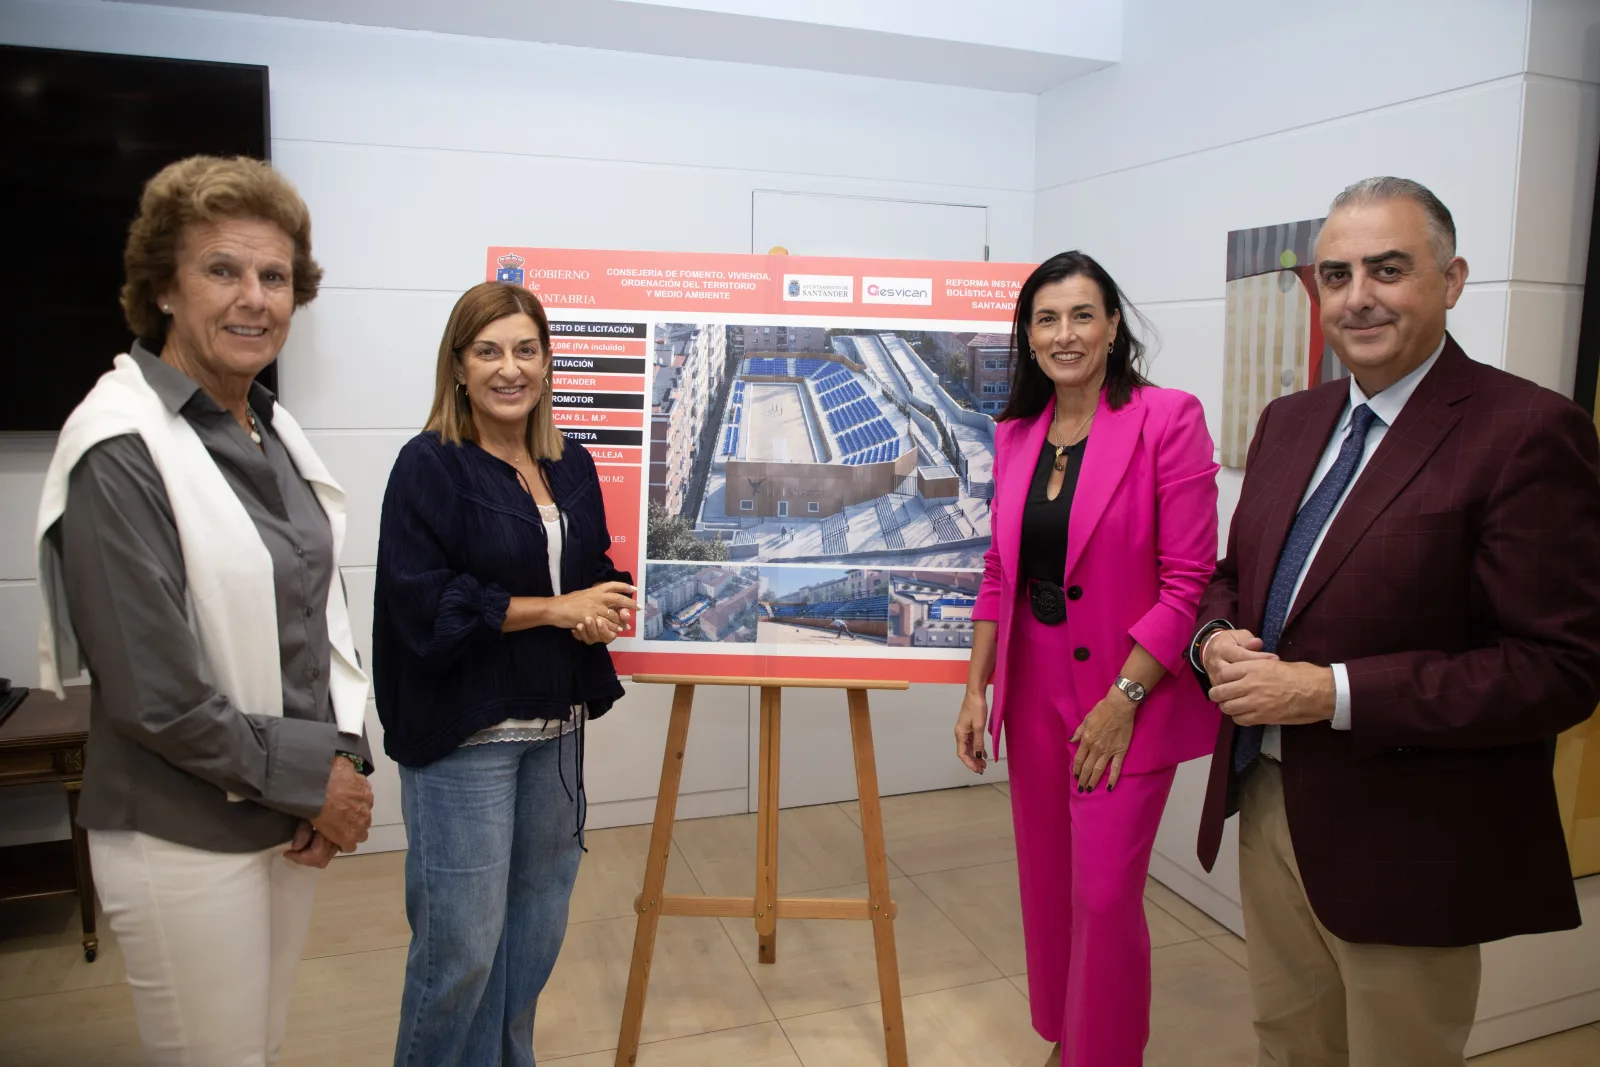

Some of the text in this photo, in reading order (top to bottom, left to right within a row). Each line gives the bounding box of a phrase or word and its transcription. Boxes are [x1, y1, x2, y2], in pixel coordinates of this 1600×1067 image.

[529, 269, 590, 280] GOBIERNO
[606, 268, 771, 281] CONSEJERÍA DE FOMENTO, VIVIENDA,
[528, 281, 540, 291] de
[621, 278, 756, 290] ORDENACIÓN DEL TERRITORIO
[945, 279, 1023, 289] REFORMA INSTAL
[654, 290, 683, 298] MEDIO
[685, 291, 731, 300] AMBIENTE
[802, 290, 849, 298] SANTANDER
[946, 288, 993, 298] BOLÍSTICA
[995, 290, 1007, 298] EL
[535, 293, 596, 304] ANTABRIA
[972, 301, 1017, 310] SANTAND
[549, 324, 635, 334] ESTO DE LICITACIÓN
[572, 342, 589, 351] (IVA
[591, 343, 626, 352] incluido)
[552, 377, 596, 386] ANTANDER
[551, 395, 594, 404] ROMOTOR
[574, 414, 590, 422] S.L.
[591, 414, 609, 423] M.P.
[588, 451, 624, 459] ALLEJA
[612, 475, 625, 483] M2
